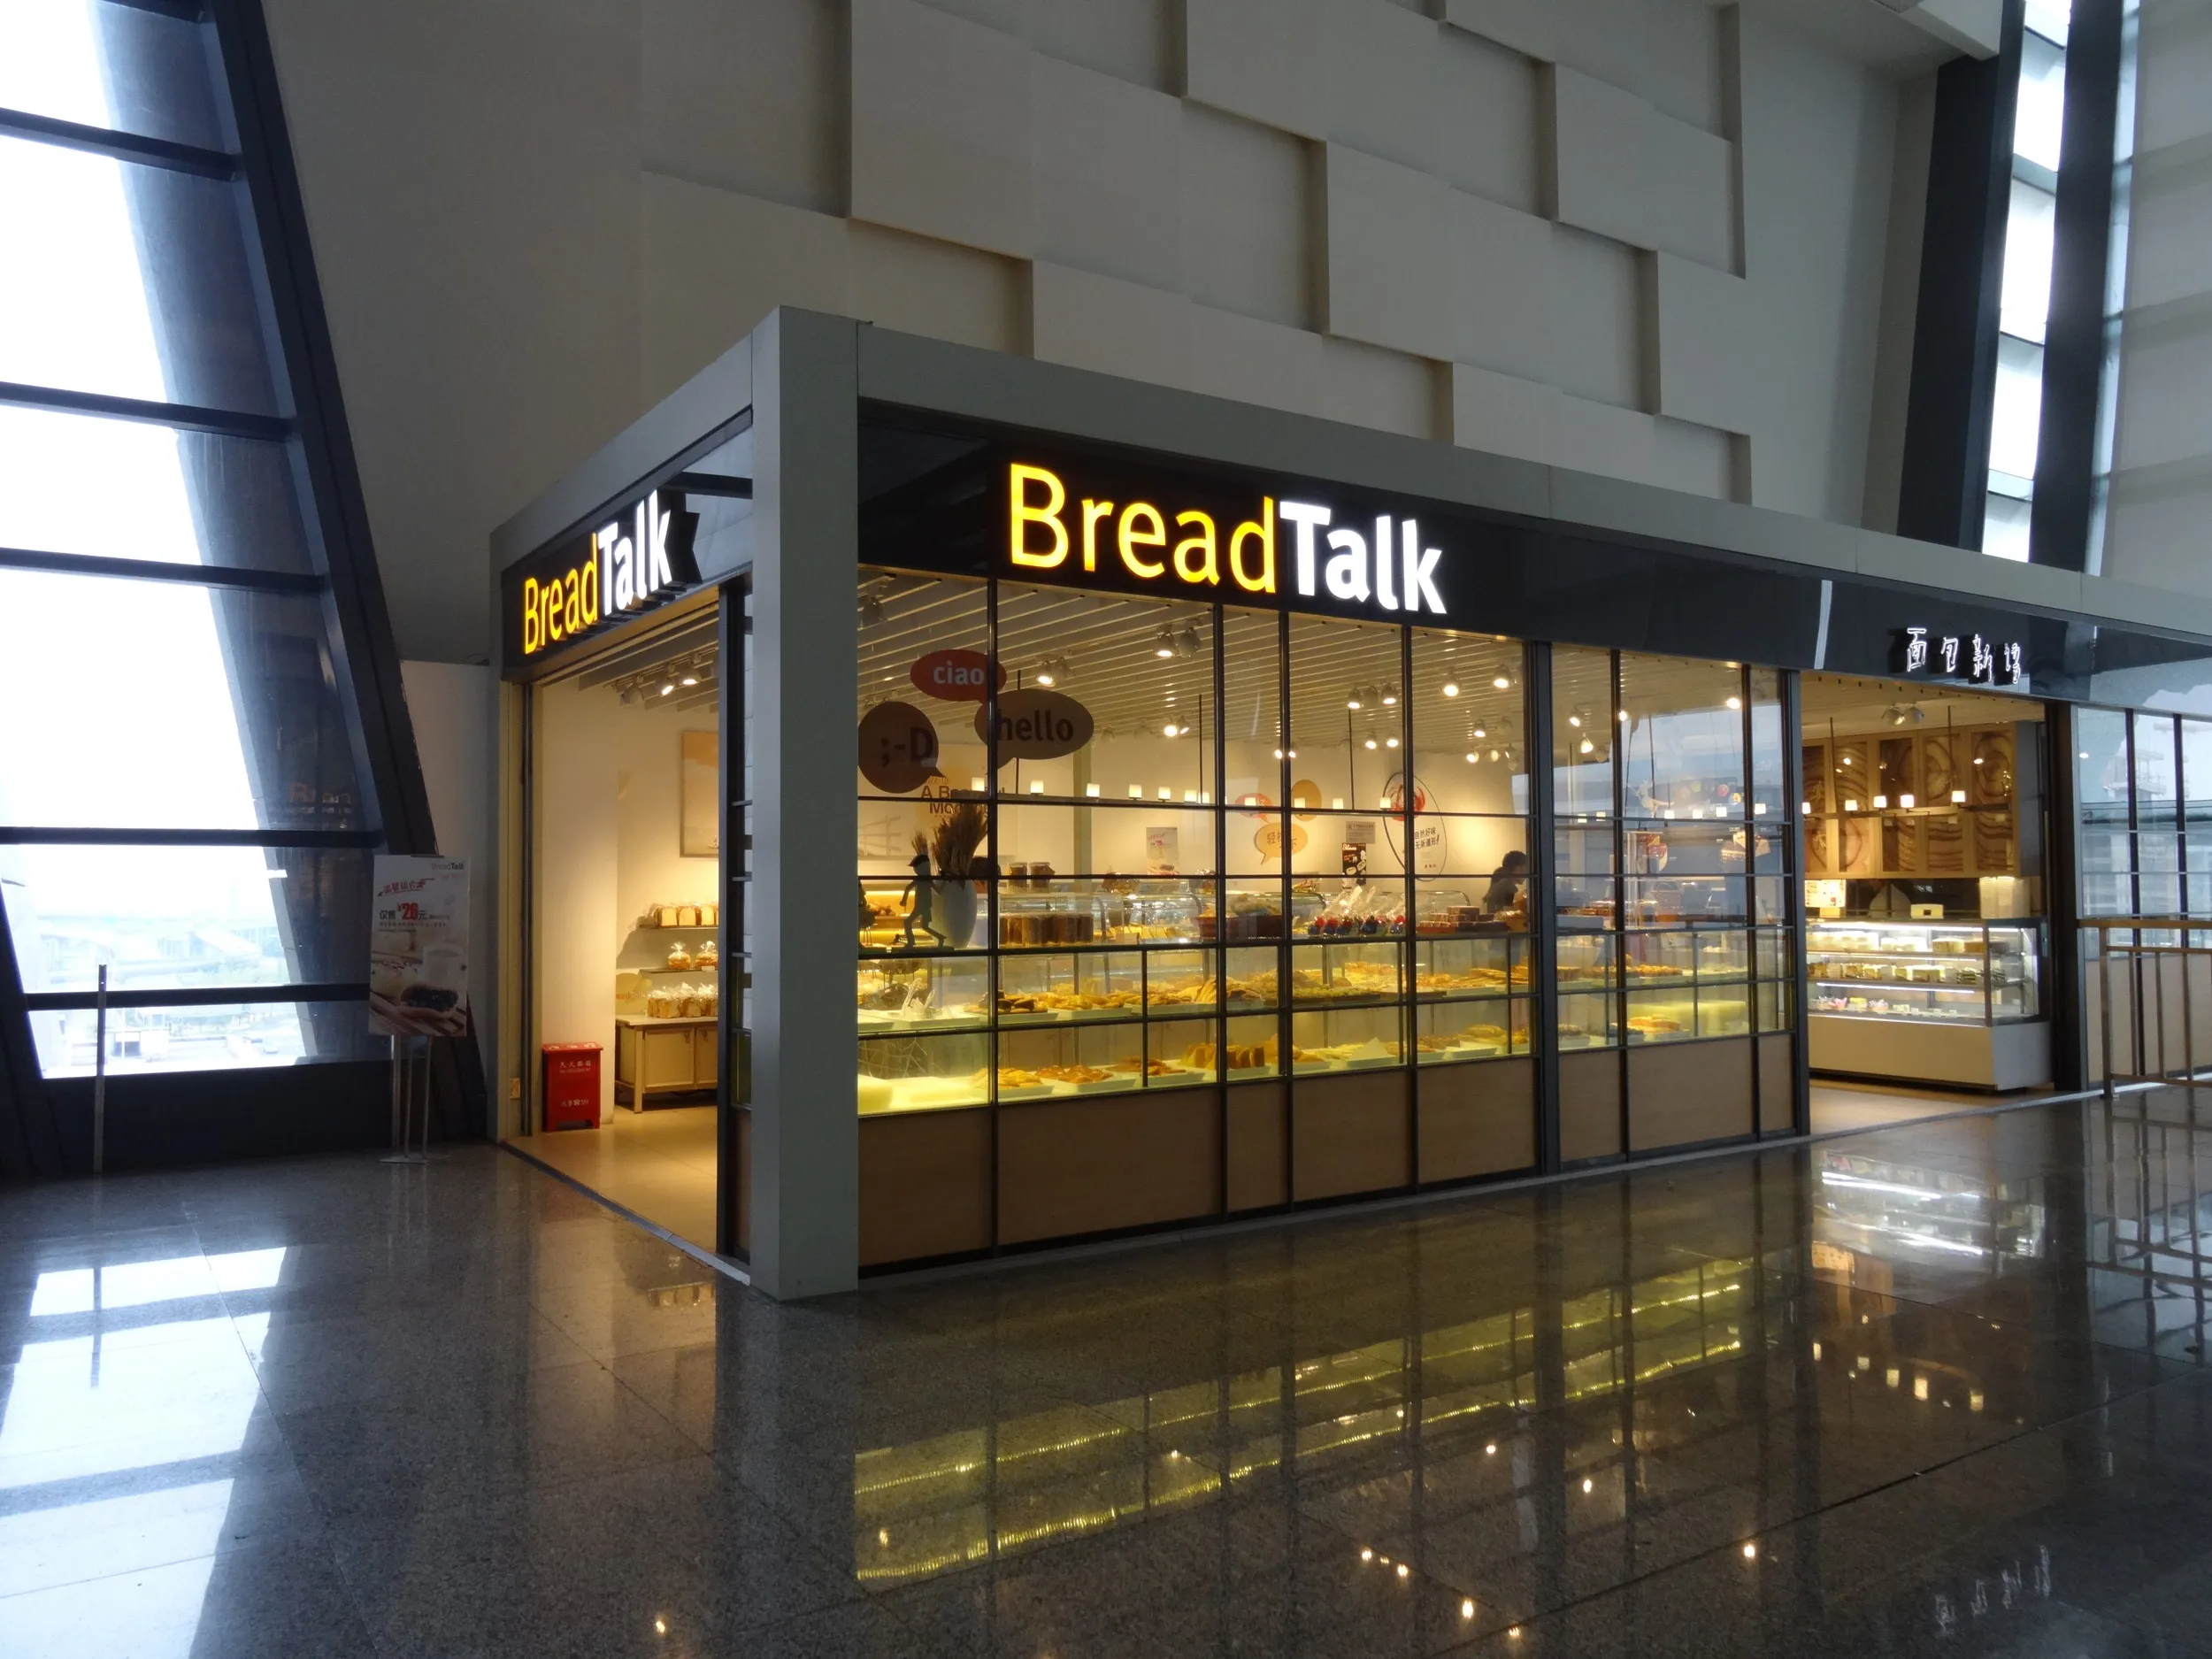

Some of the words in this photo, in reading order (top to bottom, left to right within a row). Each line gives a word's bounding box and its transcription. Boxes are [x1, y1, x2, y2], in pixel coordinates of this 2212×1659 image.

[1009, 462, 1448, 614] BreadTalk
[523, 488, 673, 655] BreadTalk
[933, 660, 985, 685] ciao
[1907, 627, 2021, 684] 面包新语
[996, 708, 1074, 741] hello
